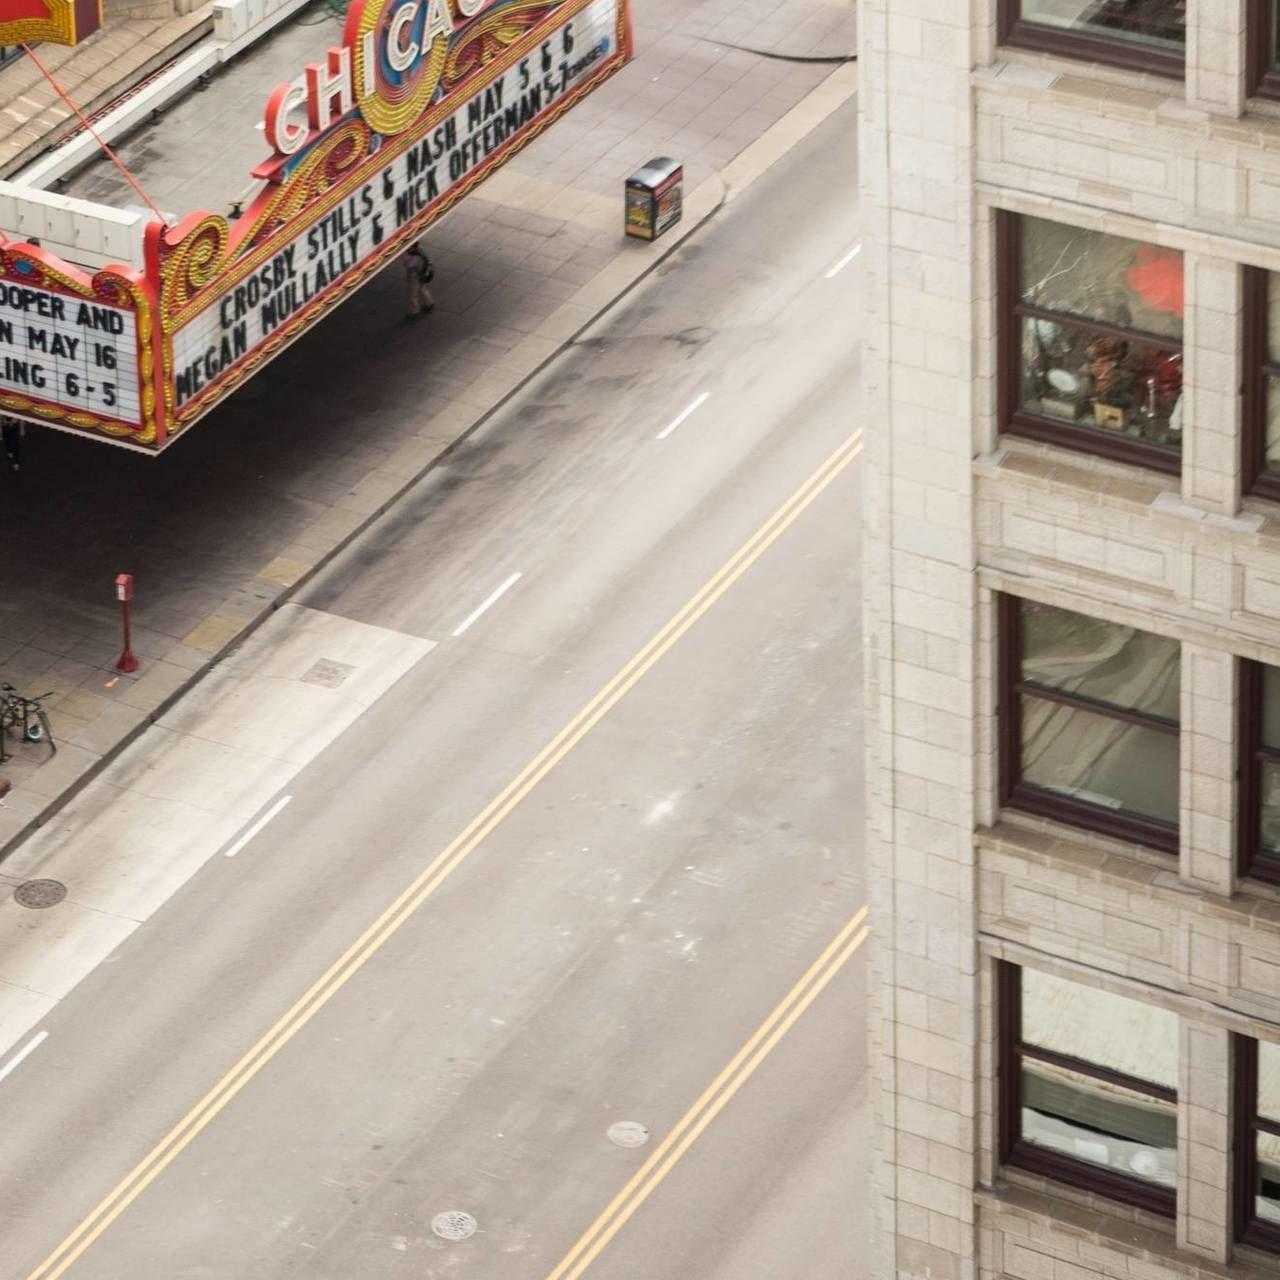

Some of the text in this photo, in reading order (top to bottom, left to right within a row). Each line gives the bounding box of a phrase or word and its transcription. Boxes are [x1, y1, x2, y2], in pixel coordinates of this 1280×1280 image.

[176, 320, 247, 406] MEGAN
[261, 228, 360, 335] MULLALLY
[396, 165, 438, 227] NICK
[449, 83, 542, 182] OFFERMAN
[220, 244, 296, 329] CROSBY
[307, 184, 373, 260] STILLS
[407, 117, 457, 183] NASH
[468, 76, 504, 134] MAY
[519, 57, 530, 90] 5
[563, 23, 574, 54] 6
[28, 326, 79, 361] MAY
[95, 345, 118, 369] 16
[76, 302, 124, 335] AND
